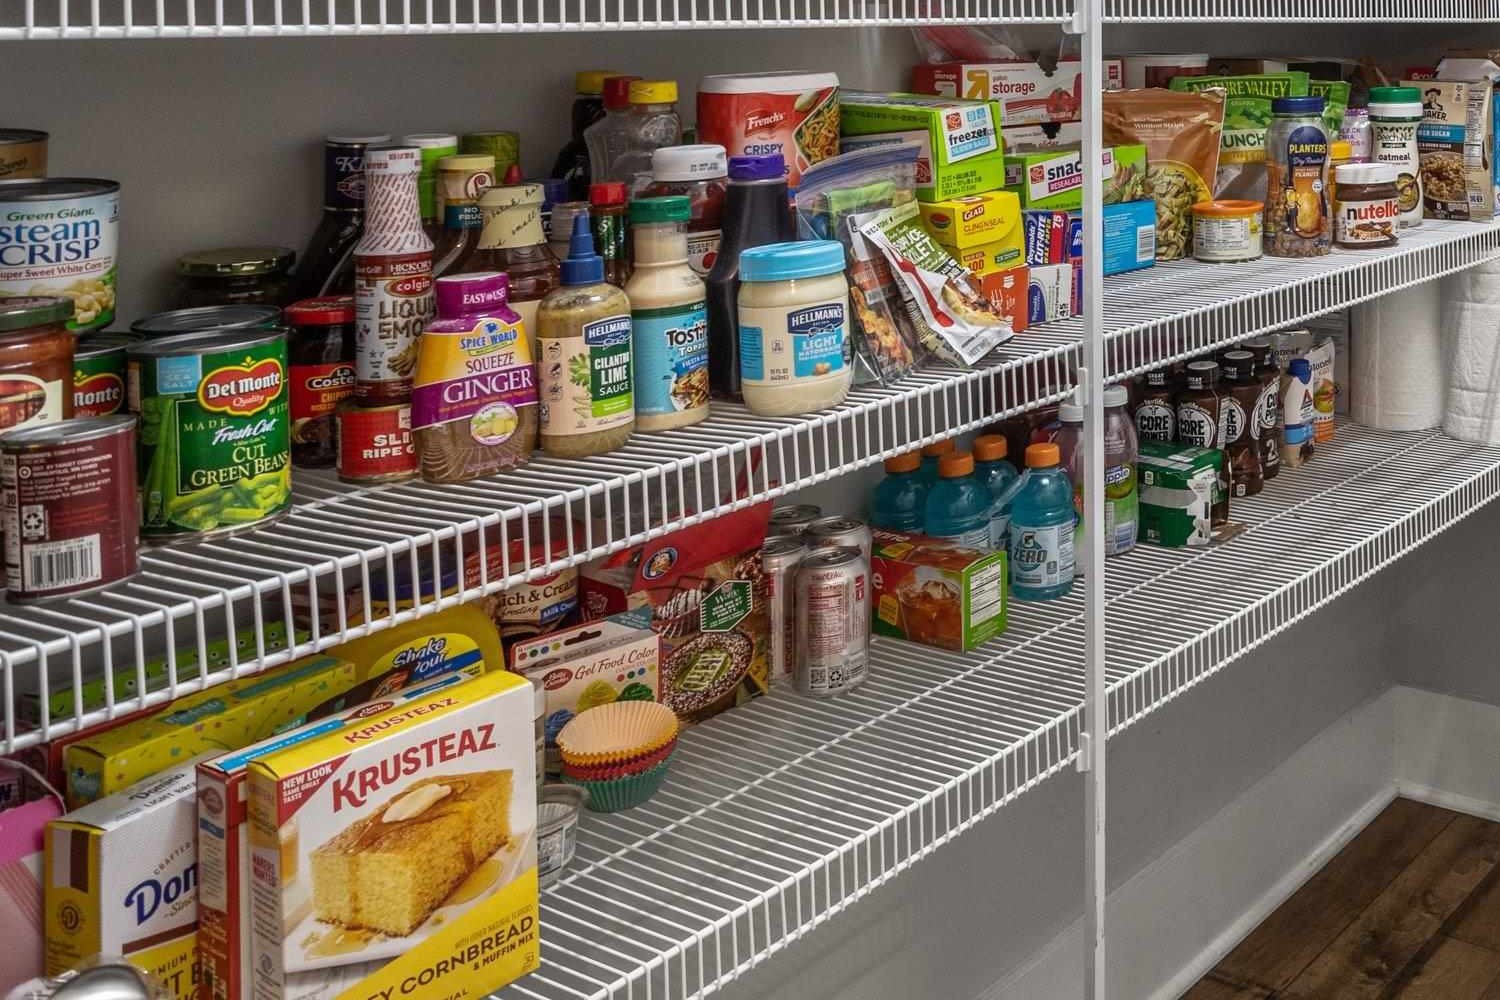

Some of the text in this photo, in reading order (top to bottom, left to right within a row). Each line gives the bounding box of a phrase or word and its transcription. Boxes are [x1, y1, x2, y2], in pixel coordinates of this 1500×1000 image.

[992, 80, 1036, 96] storage
[1246, 80, 1289, 98] VALLEY
[747, 112, 785, 131] French's
[1423, 110, 1447, 120] AKER
[949, 127, 988, 146] freezer
[1220, 132, 1265, 148] UNCH
[743, 143, 784, 155] CRISPY
[1289, 143, 1328, 154] PLANTERS
[1378, 152, 1411, 161] oatmeal
[1047, 159, 1082, 181] snac
[1050, 176, 1082, 190] RESEALABL
[7, 208, 94, 222] Green Giant
[458, 213, 482, 221] FRUC
[964, 205, 984, 221] GLAD
[1347, 201, 1400, 221] nutella
[1052, 214, 1062, 229] 75
[0, 218, 101, 245] steam
[1035, 214, 1047, 264] CUT-RITE
[0, 238, 100, 267] CRISP
[0, 269, 22, 280] uper
[24, 267, 56, 278] Sweet
[57, 264, 84, 275] White
[396, 278, 431, 293] colgin
[463, 293, 487, 305] EASY
[378, 299, 438, 320] LIQUI
[791, 308, 843, 328] HELLMANN'S
[378, 320, 423, 341] SMO
[460, 329, 518, 350] SPICE WORLD
[802, 334, 838, 350] LIGHT
[465, 351, 515, 374] SQUEEZE
[312, 374, 355, 389] Coste
[601, 365, 628, 385] LIME
[207, 371, 280, 399] Del Monte
[443, 368, 533, 403] GINGER
[600, 382, 629, 396] SAUCE
[184, 417, 229, 432] MADE
[1140, 415, 1169, 431] CORE
[1179, 419, 1205, 436] CORE
[212, 425, 252, 446] Fresh
[373, 434, 412, 446] SLI
[232, 443, 267, 464] CUT
[362, 447, 400, 459] RIPE
[191, 464, 249, 488] GREEN
[1104, 468, 1131, 484] pple
[1013, 550, 1048, 563] ZERO
[501, 579, 578, 607] ich & Crea
[392, 636, 447, 668] Shake
[574, 646, 656, 681] Gel Food Color
[344, 697, 459, 744] KRUSTEAZ
[283, 764, 333, 790] NEW LOOK
[332, 723, 497, 813] KRUSTEAZ
[400, 916, 533, 997] CORNBREAD
[482, 941, 517, 967] MUFFIN
[517, 933, 534, 948] MIX
[153, 953, 188, 975] MIUM
